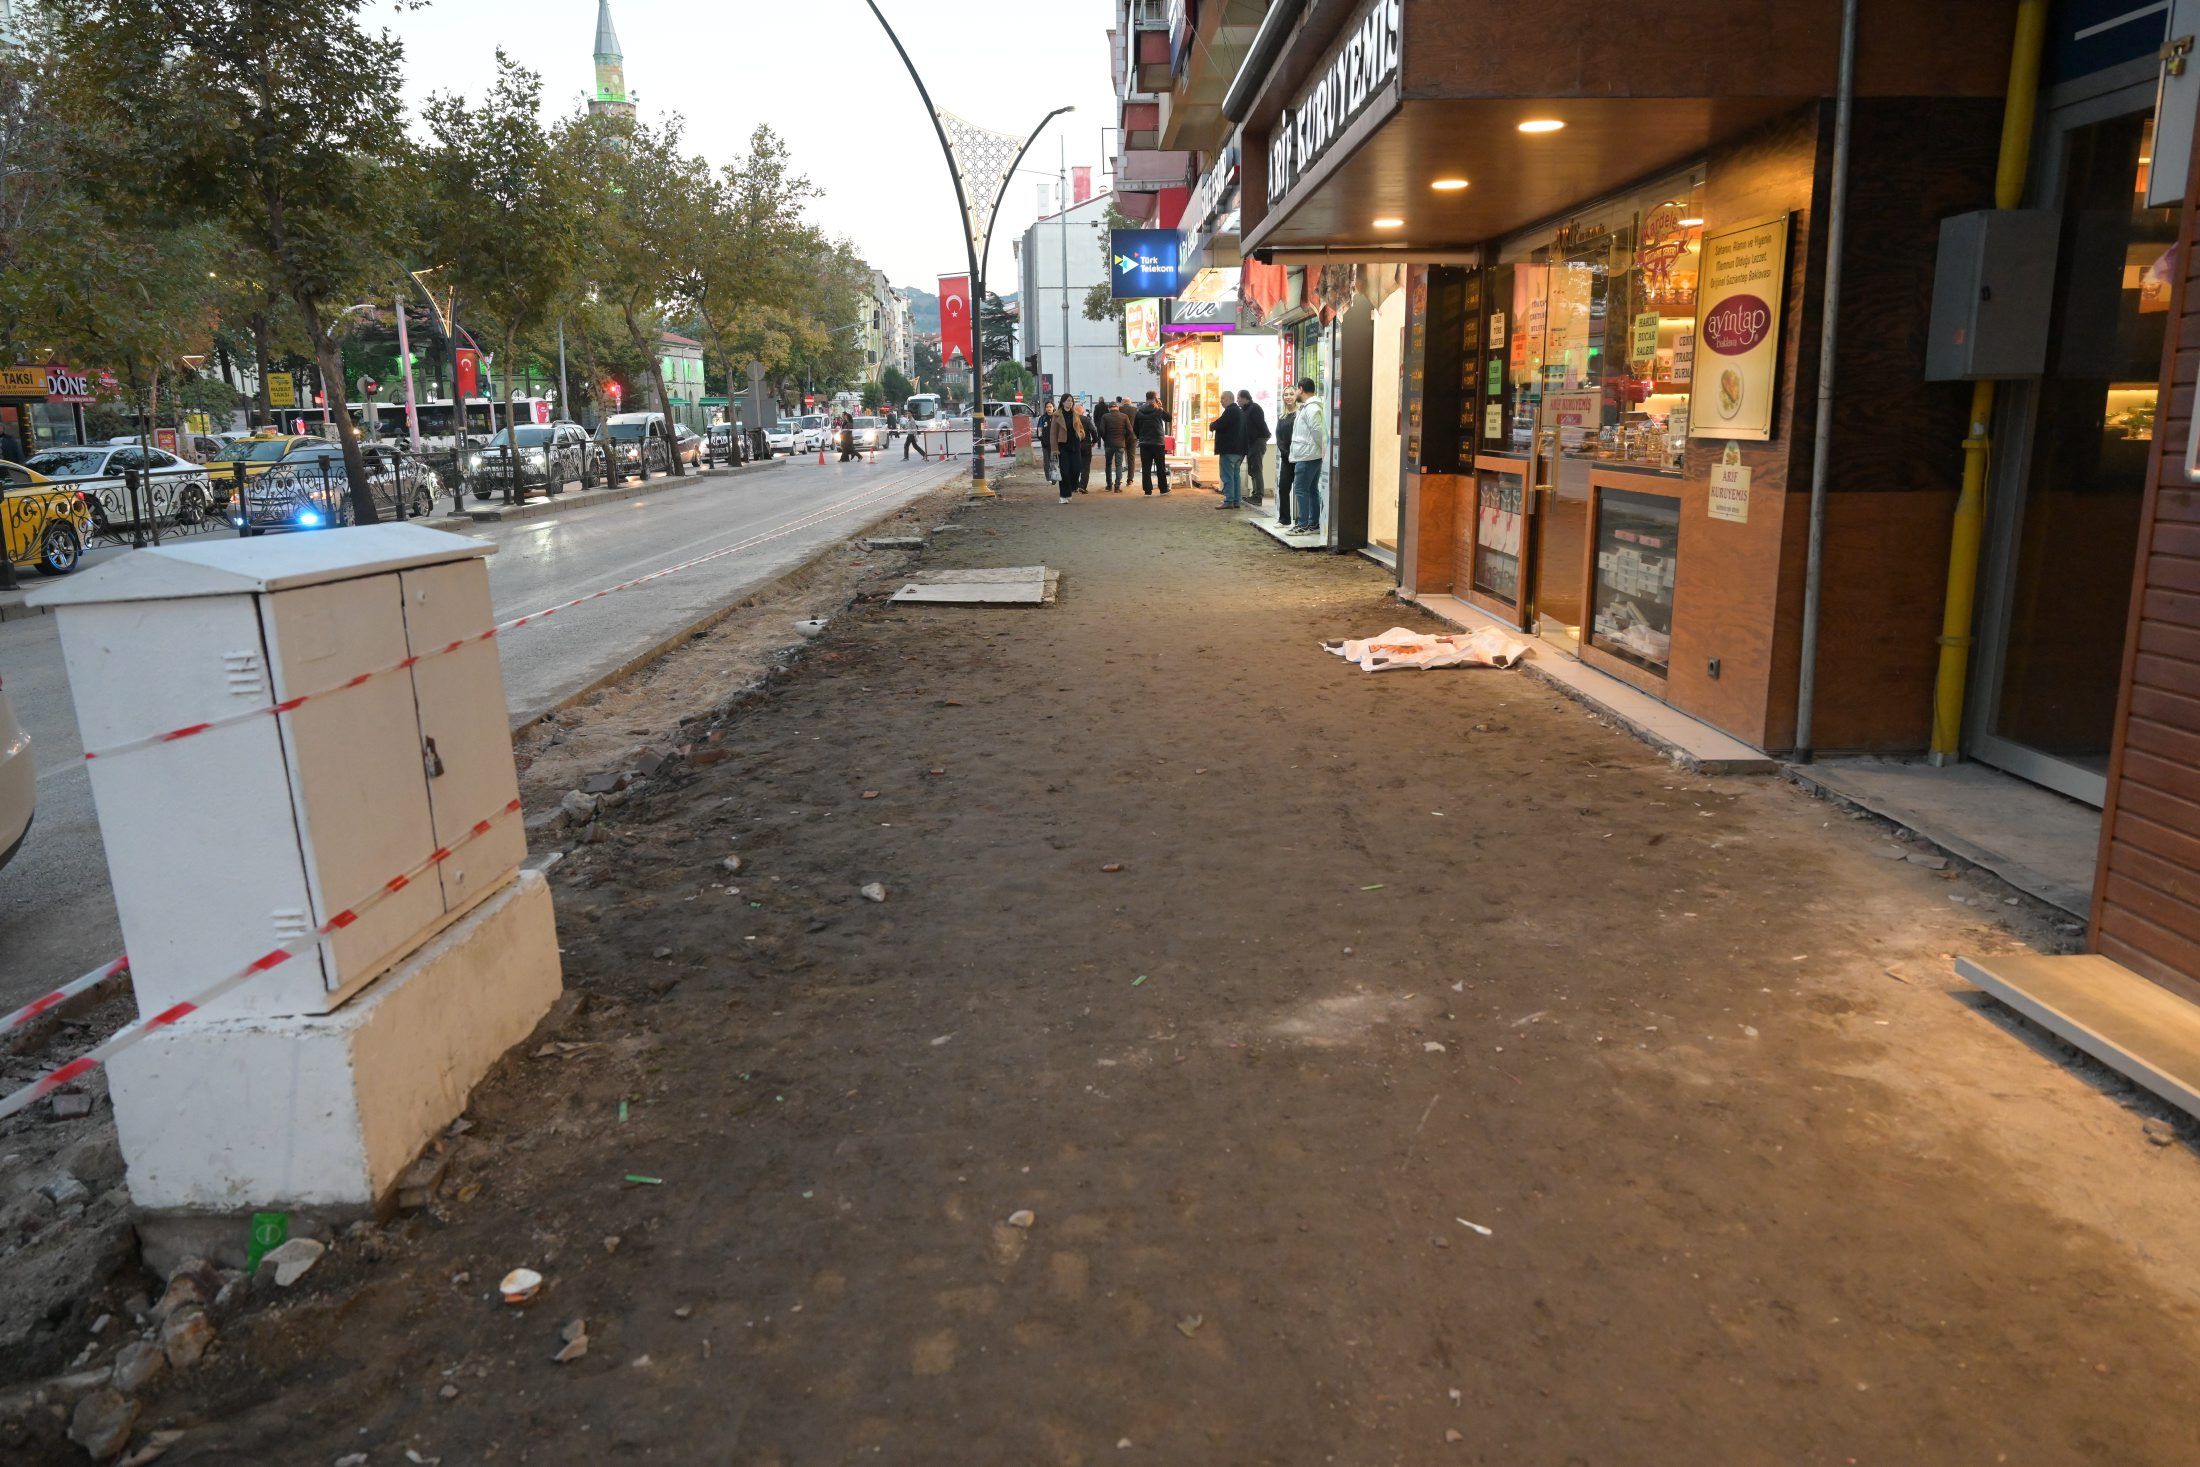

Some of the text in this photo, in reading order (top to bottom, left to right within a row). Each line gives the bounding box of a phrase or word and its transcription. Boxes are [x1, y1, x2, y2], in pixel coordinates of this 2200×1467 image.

[1141, 256, 1158, 264] Türk
[1751, 252, 1767, 264] Lezzet
[1141, 264, 1174, 273] Telekom
[2, 371, 34, 385] TAKSİ
